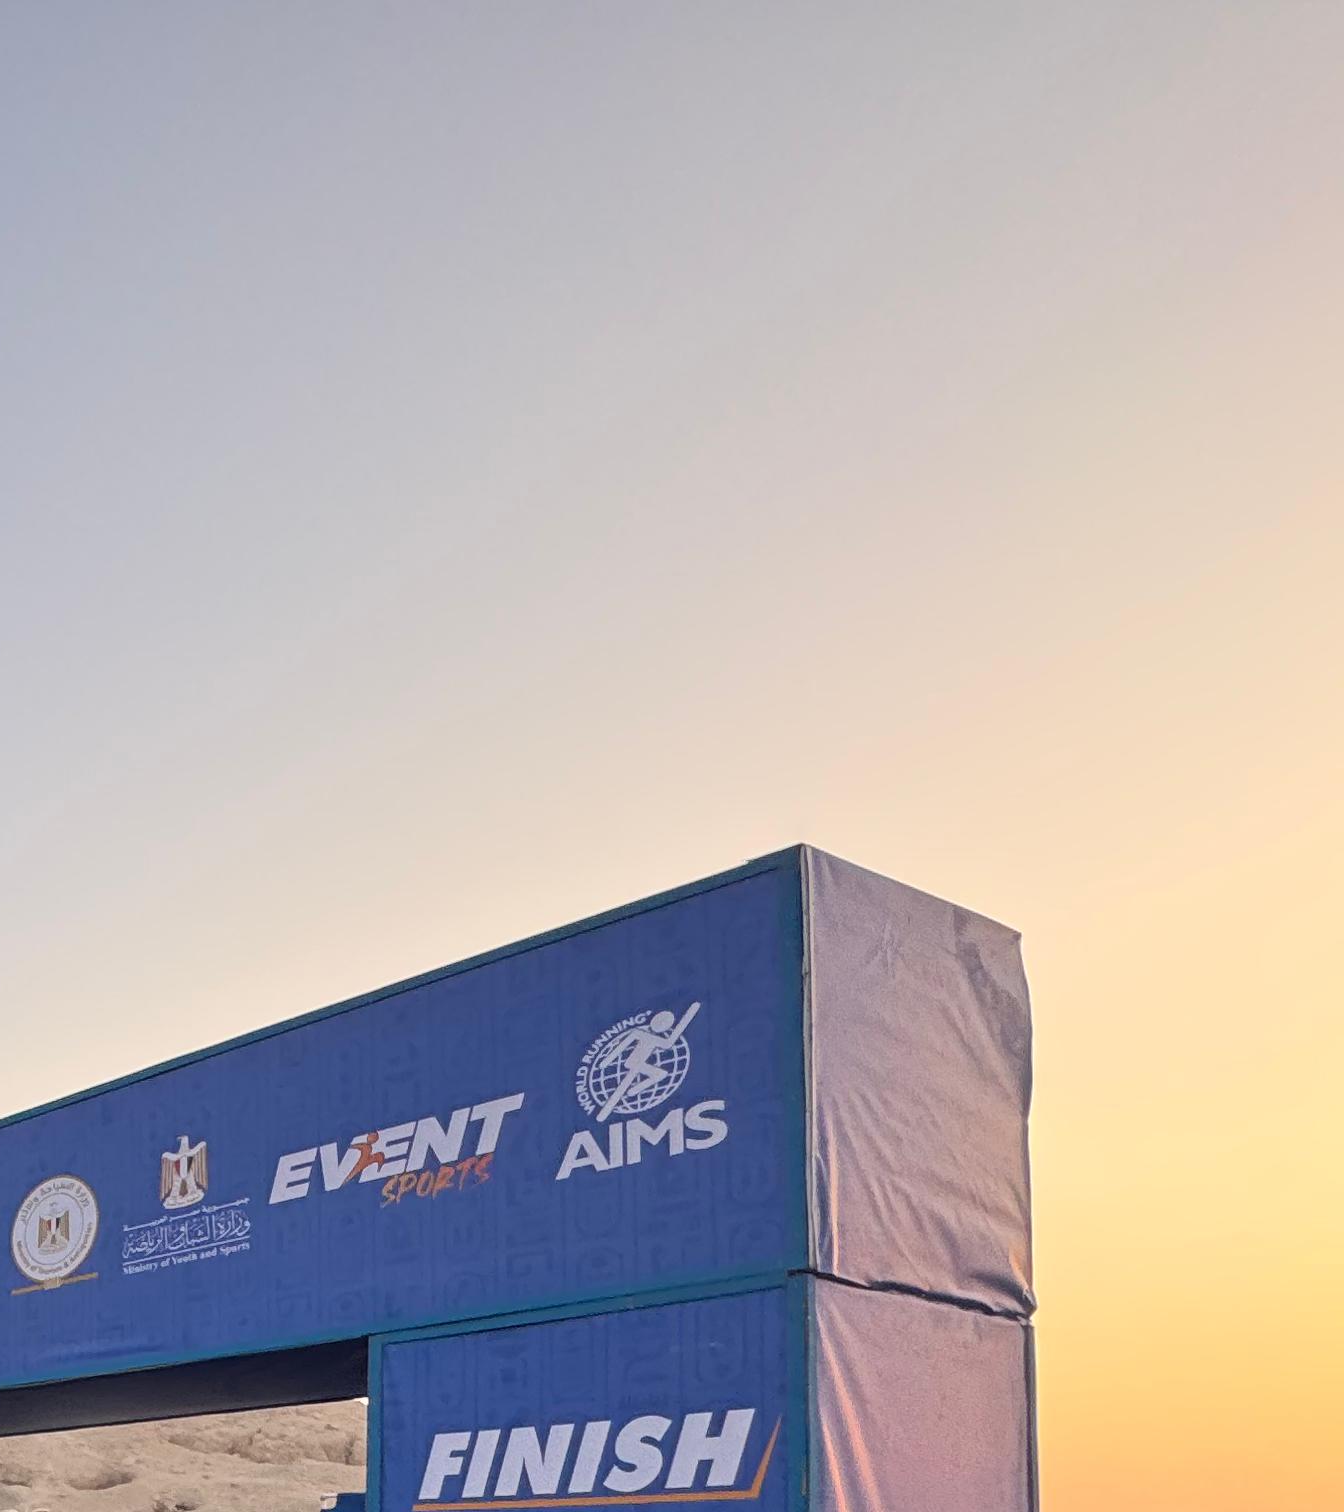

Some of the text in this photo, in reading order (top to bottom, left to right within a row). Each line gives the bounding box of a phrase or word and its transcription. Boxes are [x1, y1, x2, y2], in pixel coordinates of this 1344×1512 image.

[575, 1012, 648, 1117] WORLD RUNNING
[269, 1092, 525, 1204] EVENT
[380, 1153, 493, 1208] SPORTS
[555, 1099, 729, 1181] AIMS
[418, 1408, 756, 1500] FINISH
